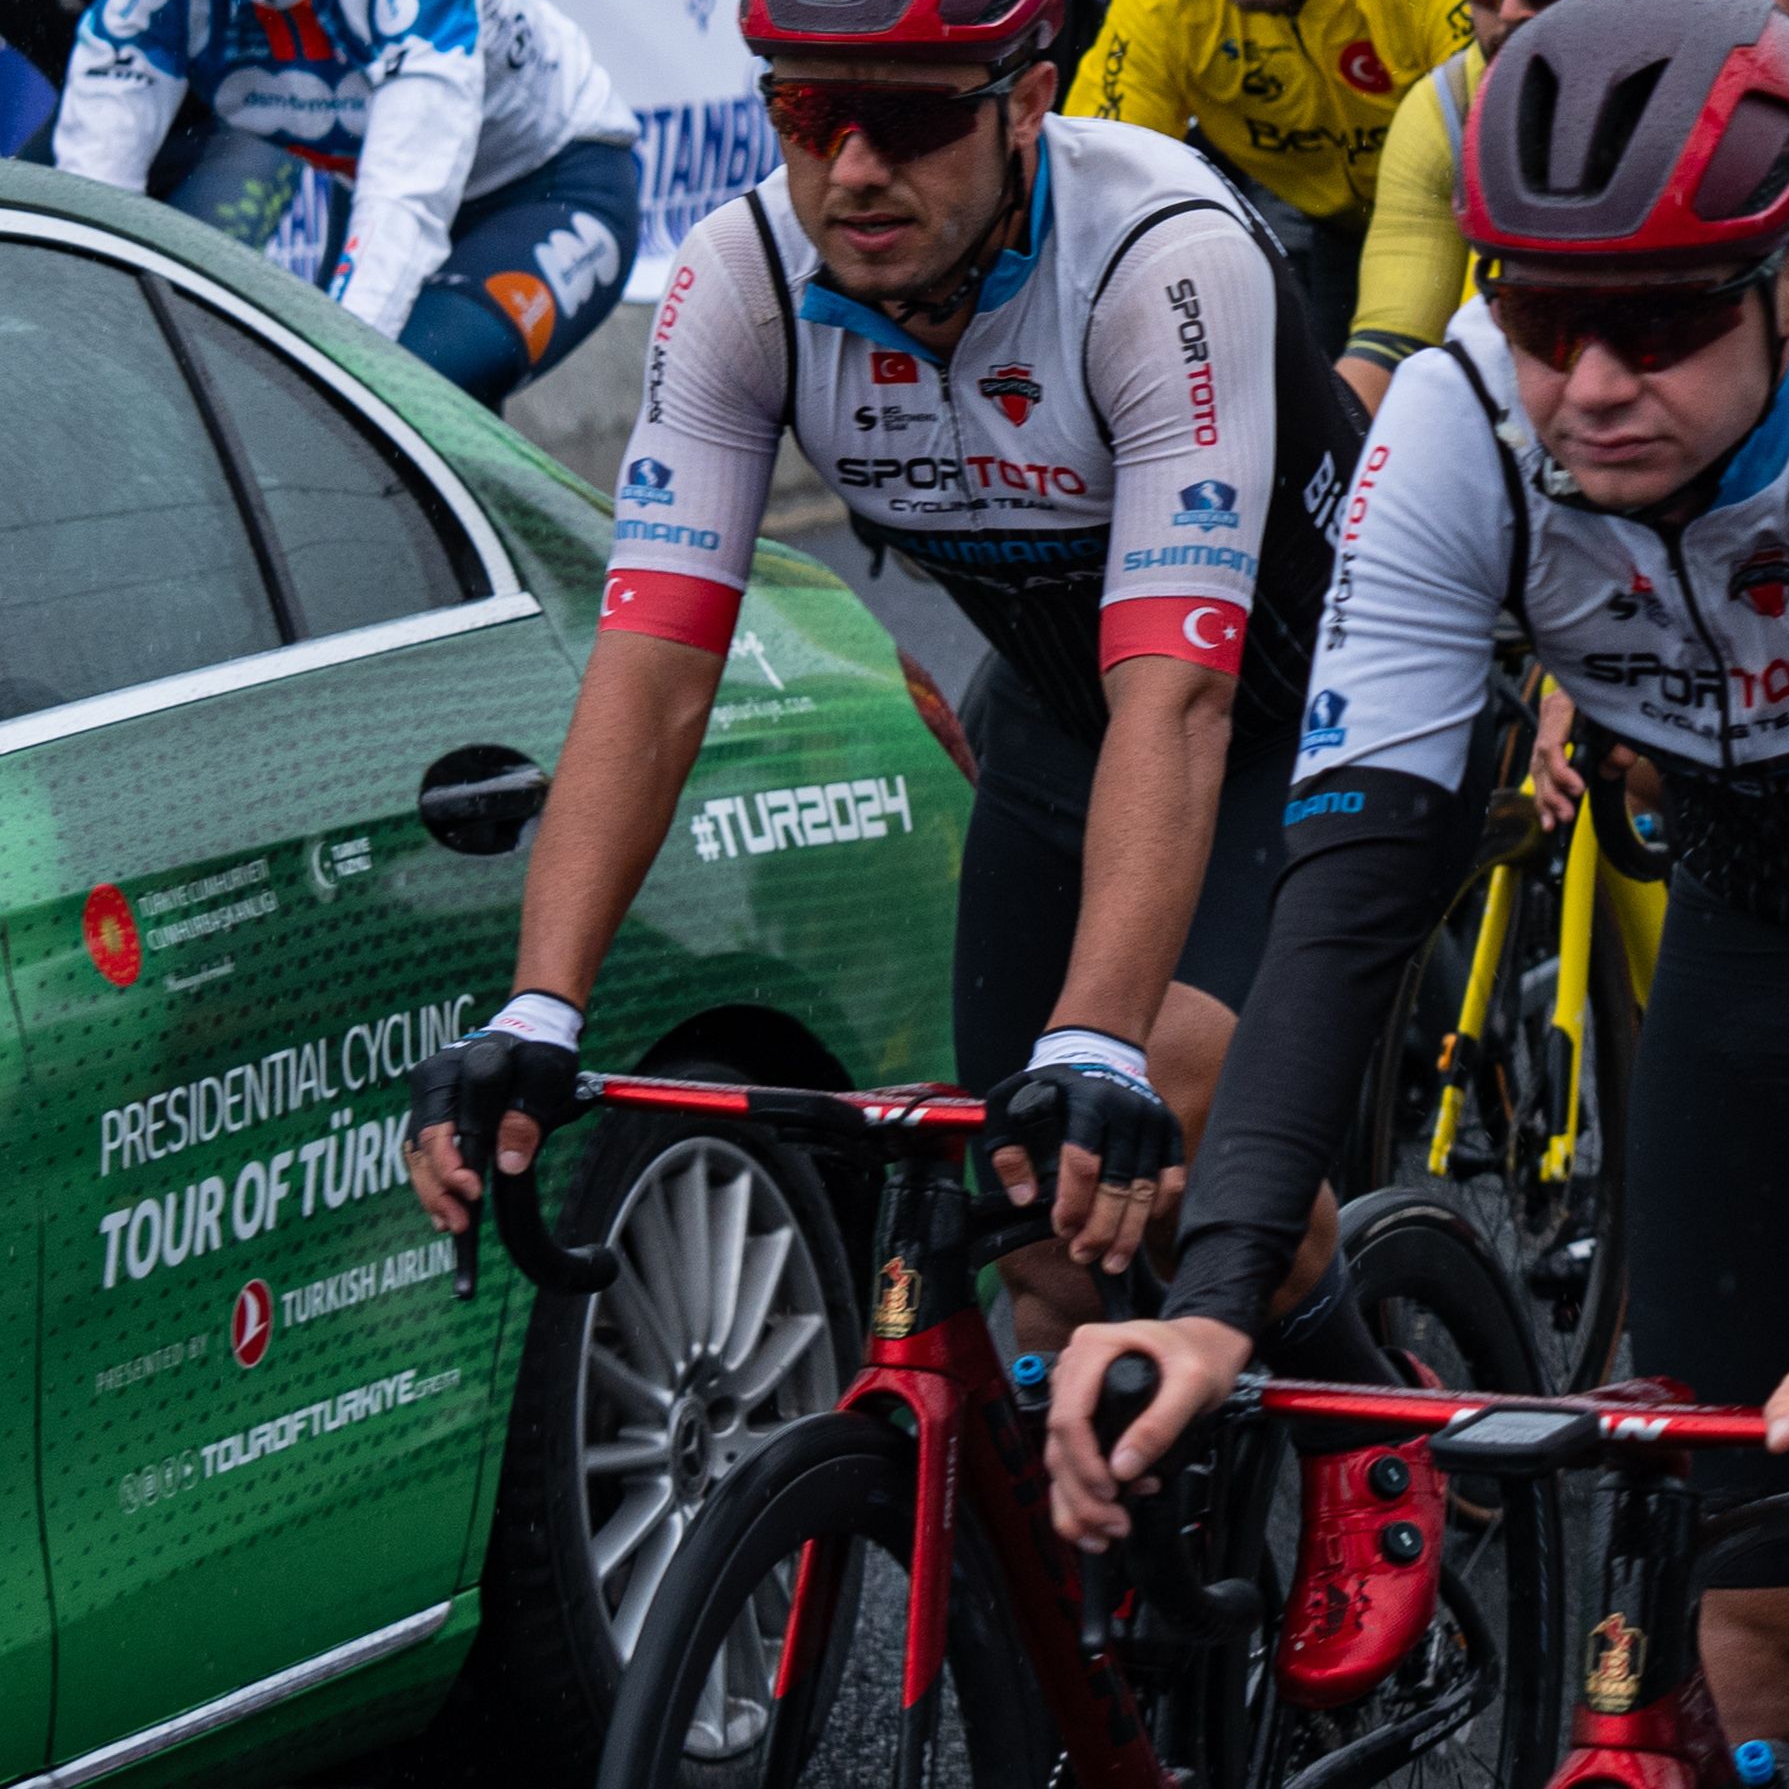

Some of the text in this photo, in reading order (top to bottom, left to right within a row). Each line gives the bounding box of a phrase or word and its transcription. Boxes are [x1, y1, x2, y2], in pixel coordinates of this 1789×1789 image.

[1165, 278, 1218, 447] SPORTOTO
[837, 456, 1088, 498] SPORTOTO
[1122, 544, 1257, 580] SHIMAN
[691, 774, 913, 862] #TUR2024
[100, 1038, 339, 1178] PRESIDENTIAL
[99, 1114, 411, 1290] TOUR OF TÜRK
[281, 1237, 458, 1328] TURKISH AIRLIN
[95, 1333, 208, 1391] PRESENTED BY
